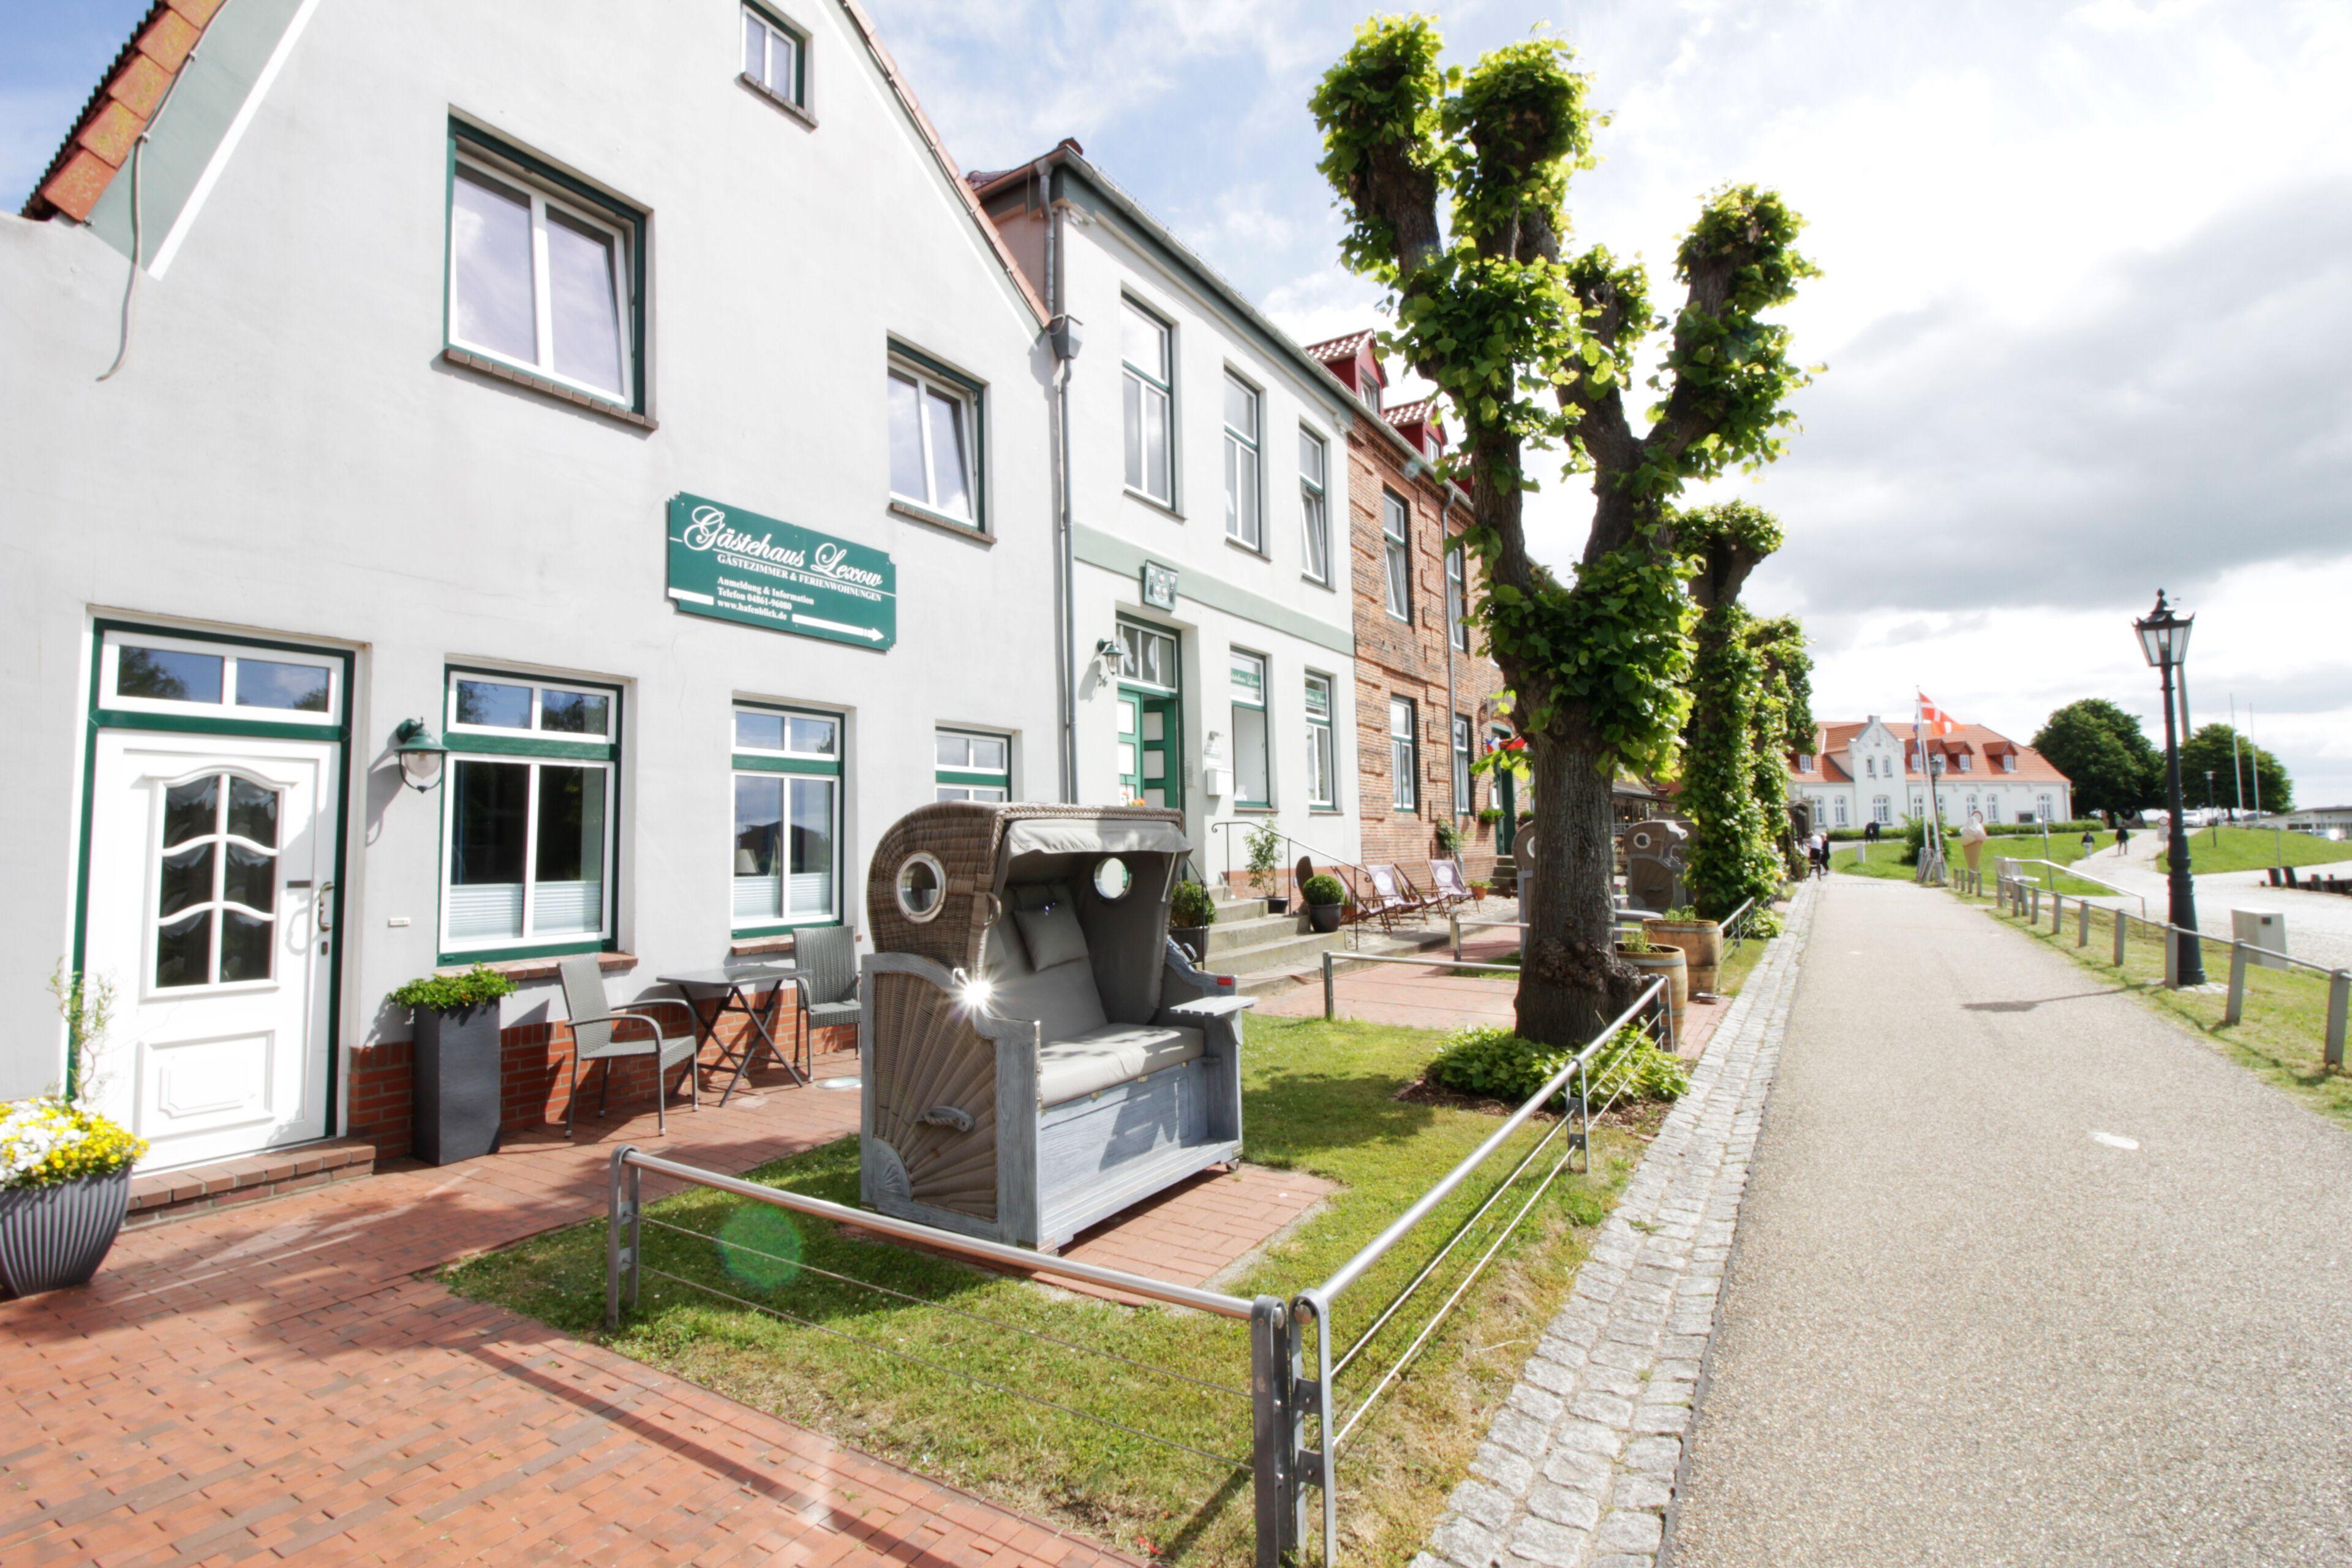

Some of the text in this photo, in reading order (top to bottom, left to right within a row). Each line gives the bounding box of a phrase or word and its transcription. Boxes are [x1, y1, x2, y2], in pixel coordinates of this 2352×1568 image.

[684, 505, 883, 587] Gästehaus Lexow
[717, 554, 789, 579] GÄSTEZIMMER
[799, 575, 882, 601] FERIENWOHNUNGEN
[717, 576, 762, 595] Anmeldung
[772, 588, 815, 605] Information
[717, 587, 746, 601] Telefon
[717, 600, 788, 620] www.hafenblick.de
